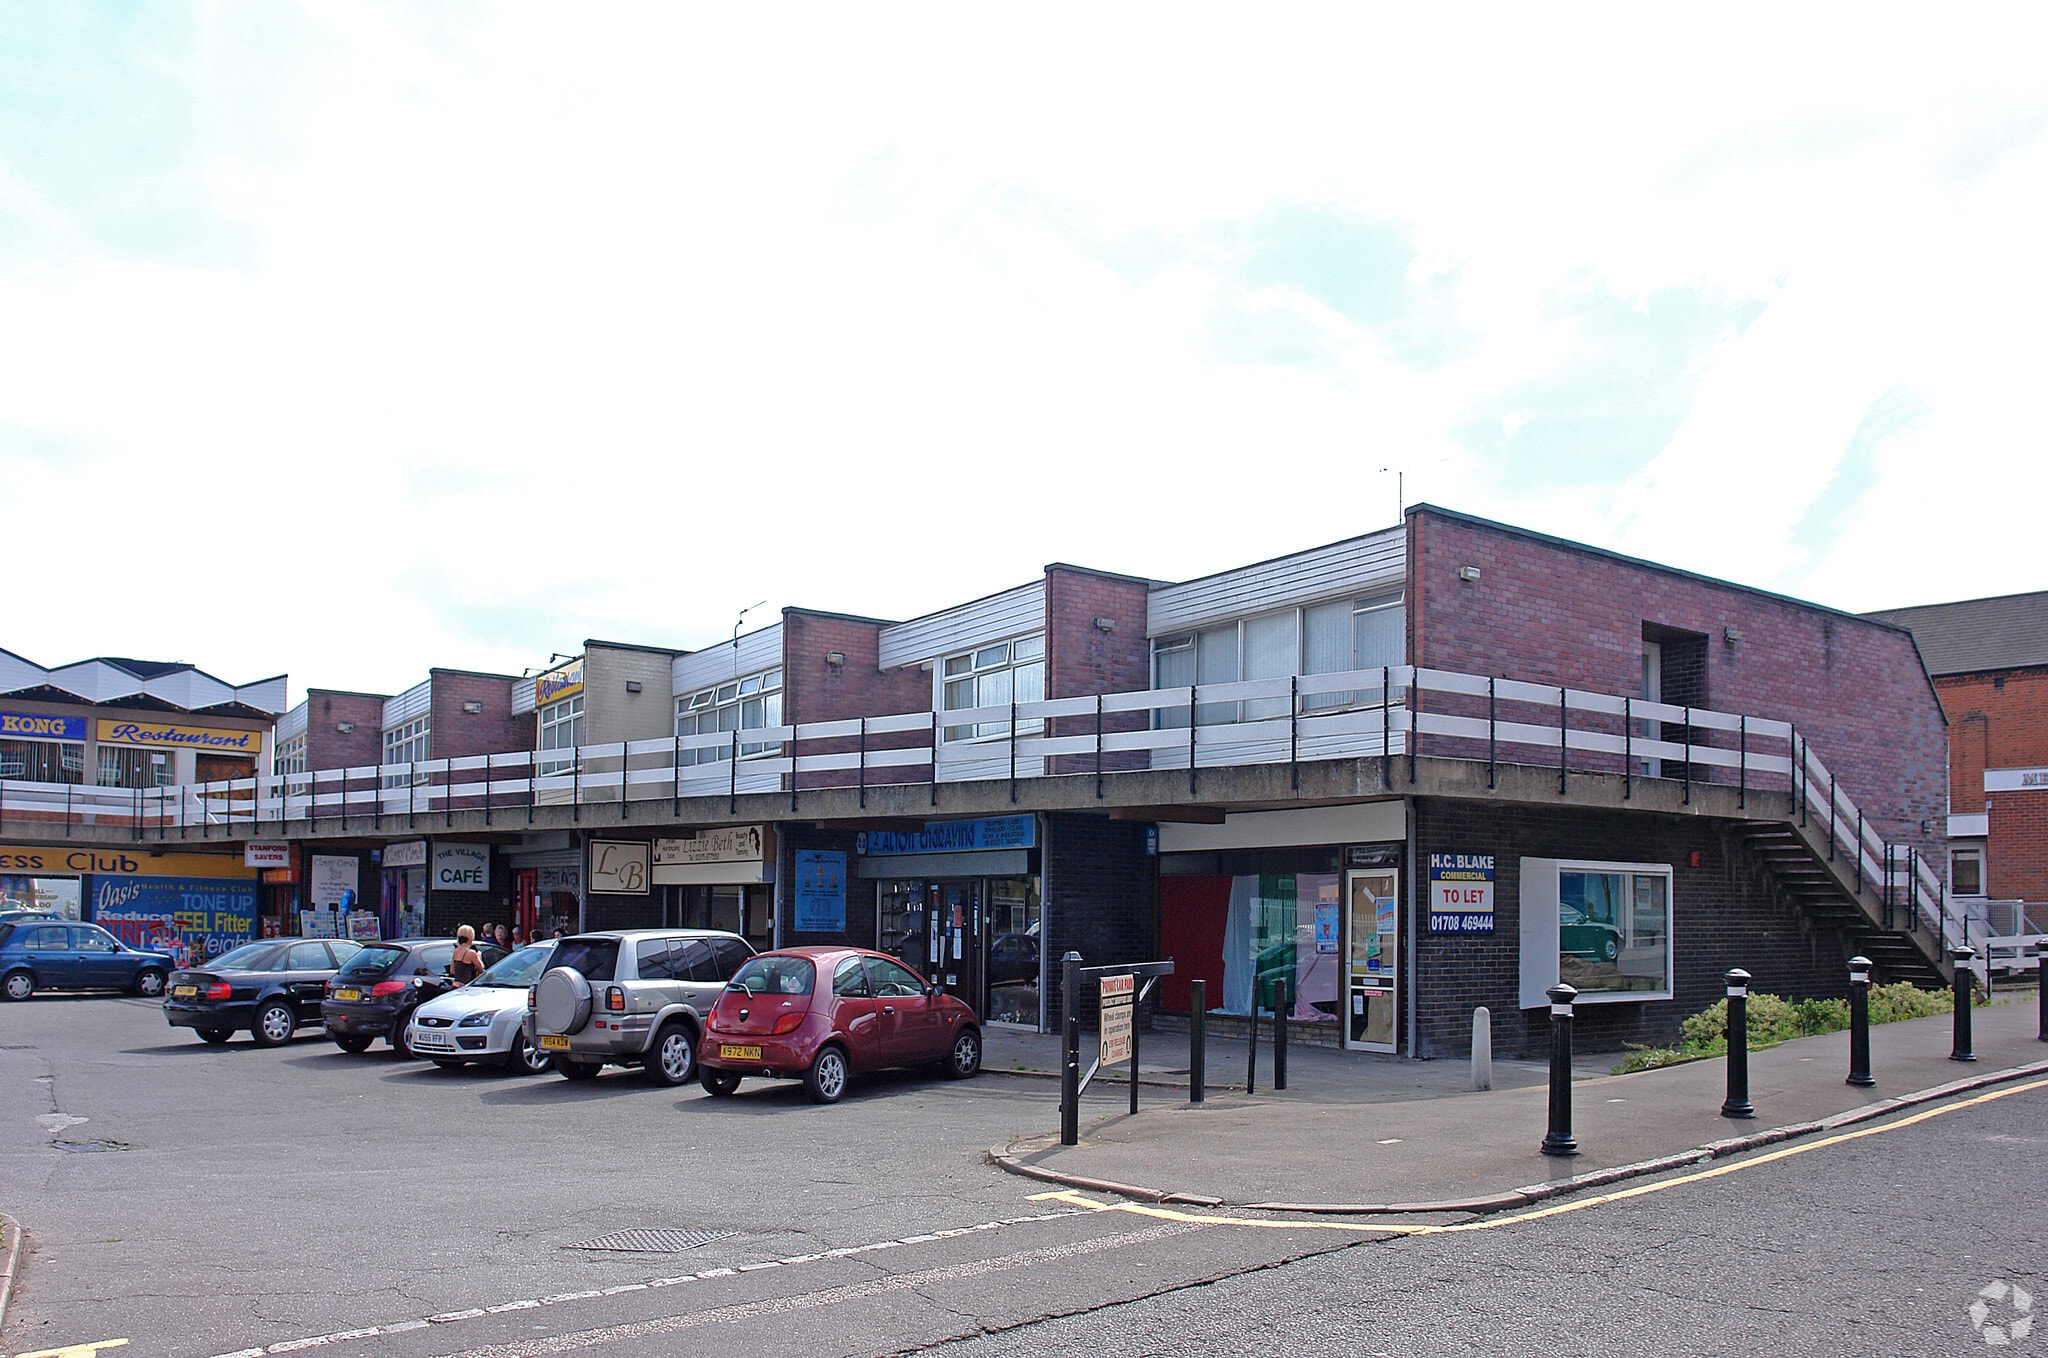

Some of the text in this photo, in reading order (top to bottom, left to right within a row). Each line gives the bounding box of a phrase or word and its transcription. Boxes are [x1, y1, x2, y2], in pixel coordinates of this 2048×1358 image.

[2, 715, 66, 734] KONG
[110, 724, 249, 747] Restaurant
[711, 832, 733, 851] Beth
[66, 852, 138, 872] Club
[437, 848, 487, 862] THE VILLAGE
[1431, 854, 1494, 869] H.C. BLAKE
[441, 866, 483, 884] CAFÉ
[1440, 871, 1486, 880] COMMERCIAL
[98, 880, 140, 911] Oasis
[141, 883, 174, 891] Health
[189, 885, 227, 893] Fitness
[181, 894, 253, 912] TONE UP
[1443, 889, 1484, 904] TO LET
[96, 911, 174, 921] Reduce
[174, 912, 252, 933] FEEL Fitter
[1431, 915, 1493, 930] 01708 469444
[743, 1047, 760, 1057] NKN
